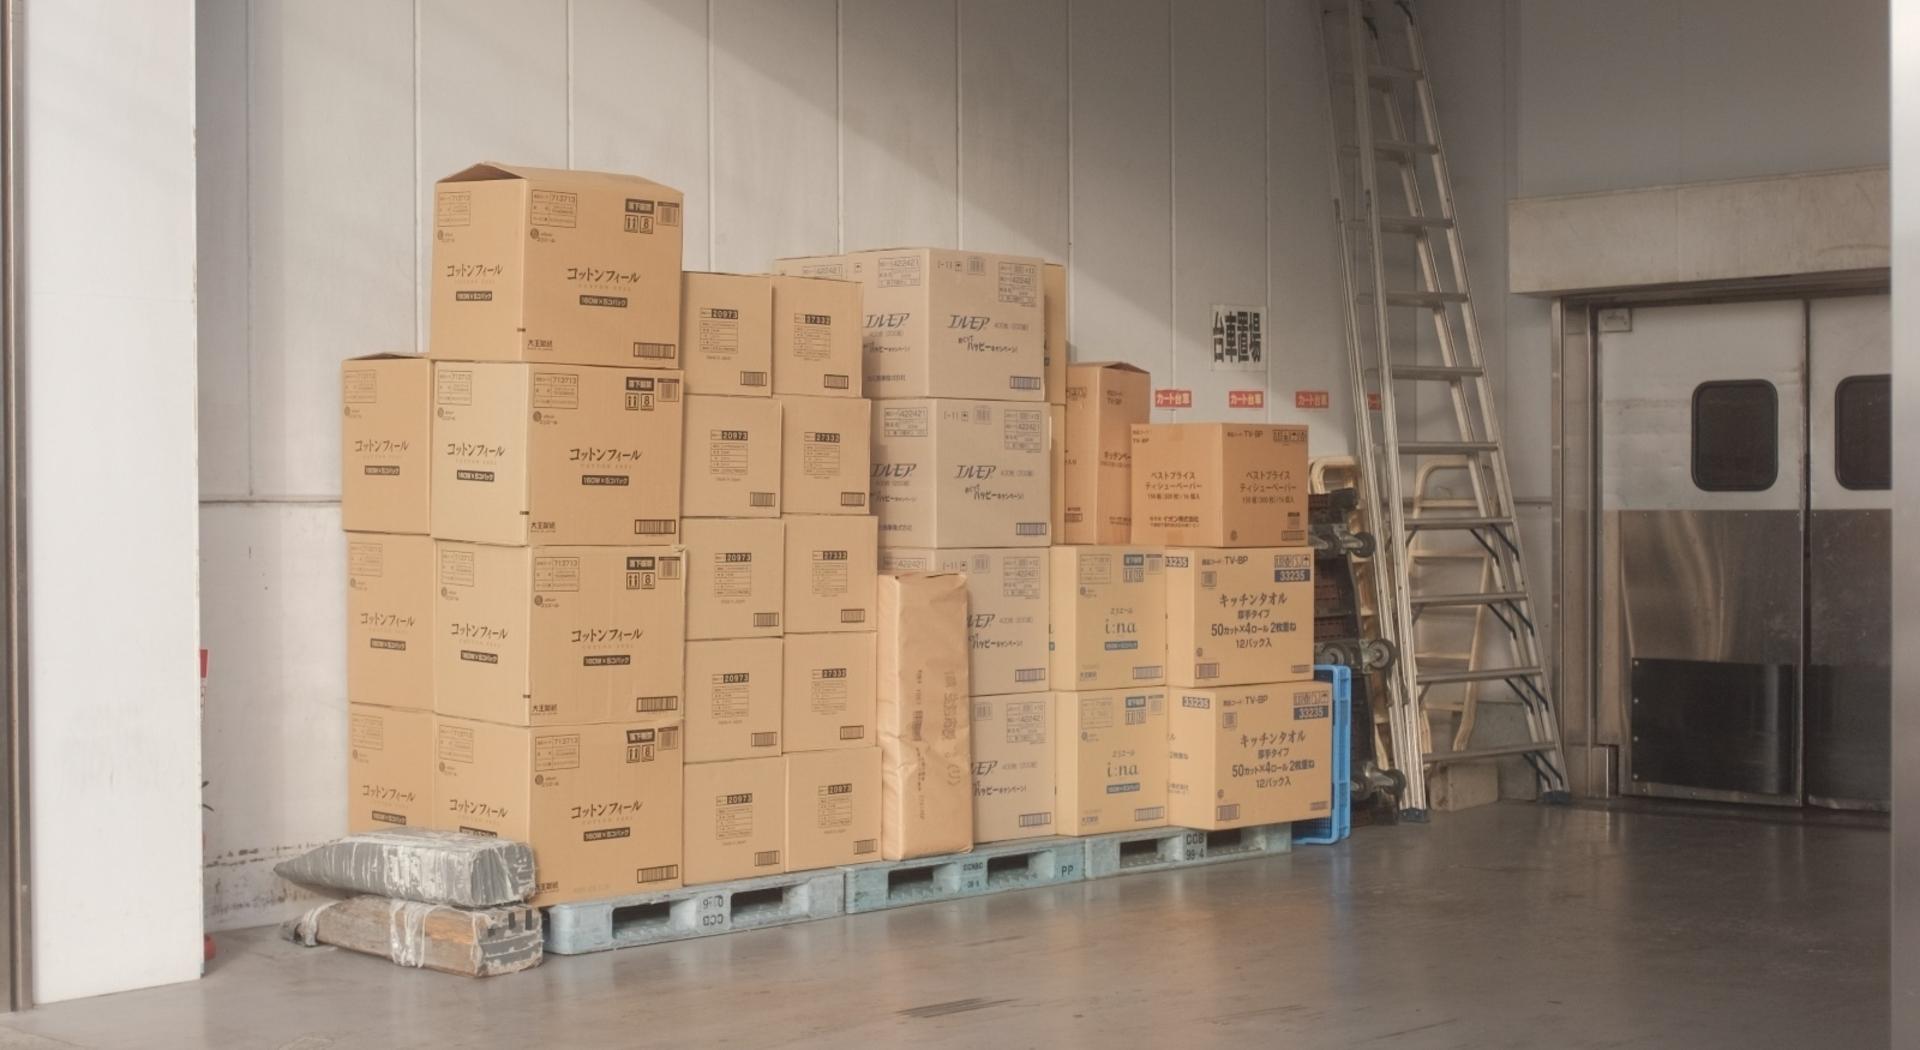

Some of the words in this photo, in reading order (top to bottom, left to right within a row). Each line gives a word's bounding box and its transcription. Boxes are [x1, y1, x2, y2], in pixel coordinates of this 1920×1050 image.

[447, 264, 504, 279] コットンフィール
[567, 267, 641, 284] コットンフィール
[866, 312, 910, 329] エルモア
[948, 314, 990, 331] エルモア
[1212, 311, 1262, 363] 台車置場
[355, 440, 409, 453] コットンフィール
[447, 442, 506, 457] コットンフィール
[569, 447, 642, 462] コットンフィール
[954, 464, 996, 480] エルモア
[1151, 471, 1195, 480] ベストプライス
[1246, 470, 1290, 480] ベストプライス
[1224, 555, 1248, 565] TV-BP
[1279, 570, 1305, 581] 33235
[1219, 592, 1287, 608] キッチンタオル
[360, 612, 415, 627] コットンフィール
[451, 622, 508, 640] コットンフィール
[571, 628, 644, 643] コットンフィール
[1236, 637, 1273, 649] 12パック入
[1245, 695, 1268, 705] TV-BP
[1240, 730, 1306, 748] キッチンタオル
[1107, 761, 1138, 778] i:na
[1255, 778, 1292, 788] 12パック入
[362, 784, 416, 802] コットンフィール
[450, 799, 509, 818] コットンフィール
[571, 799, 643, 820] コットンフィール
[1061, 865, 1074, 877] PP
